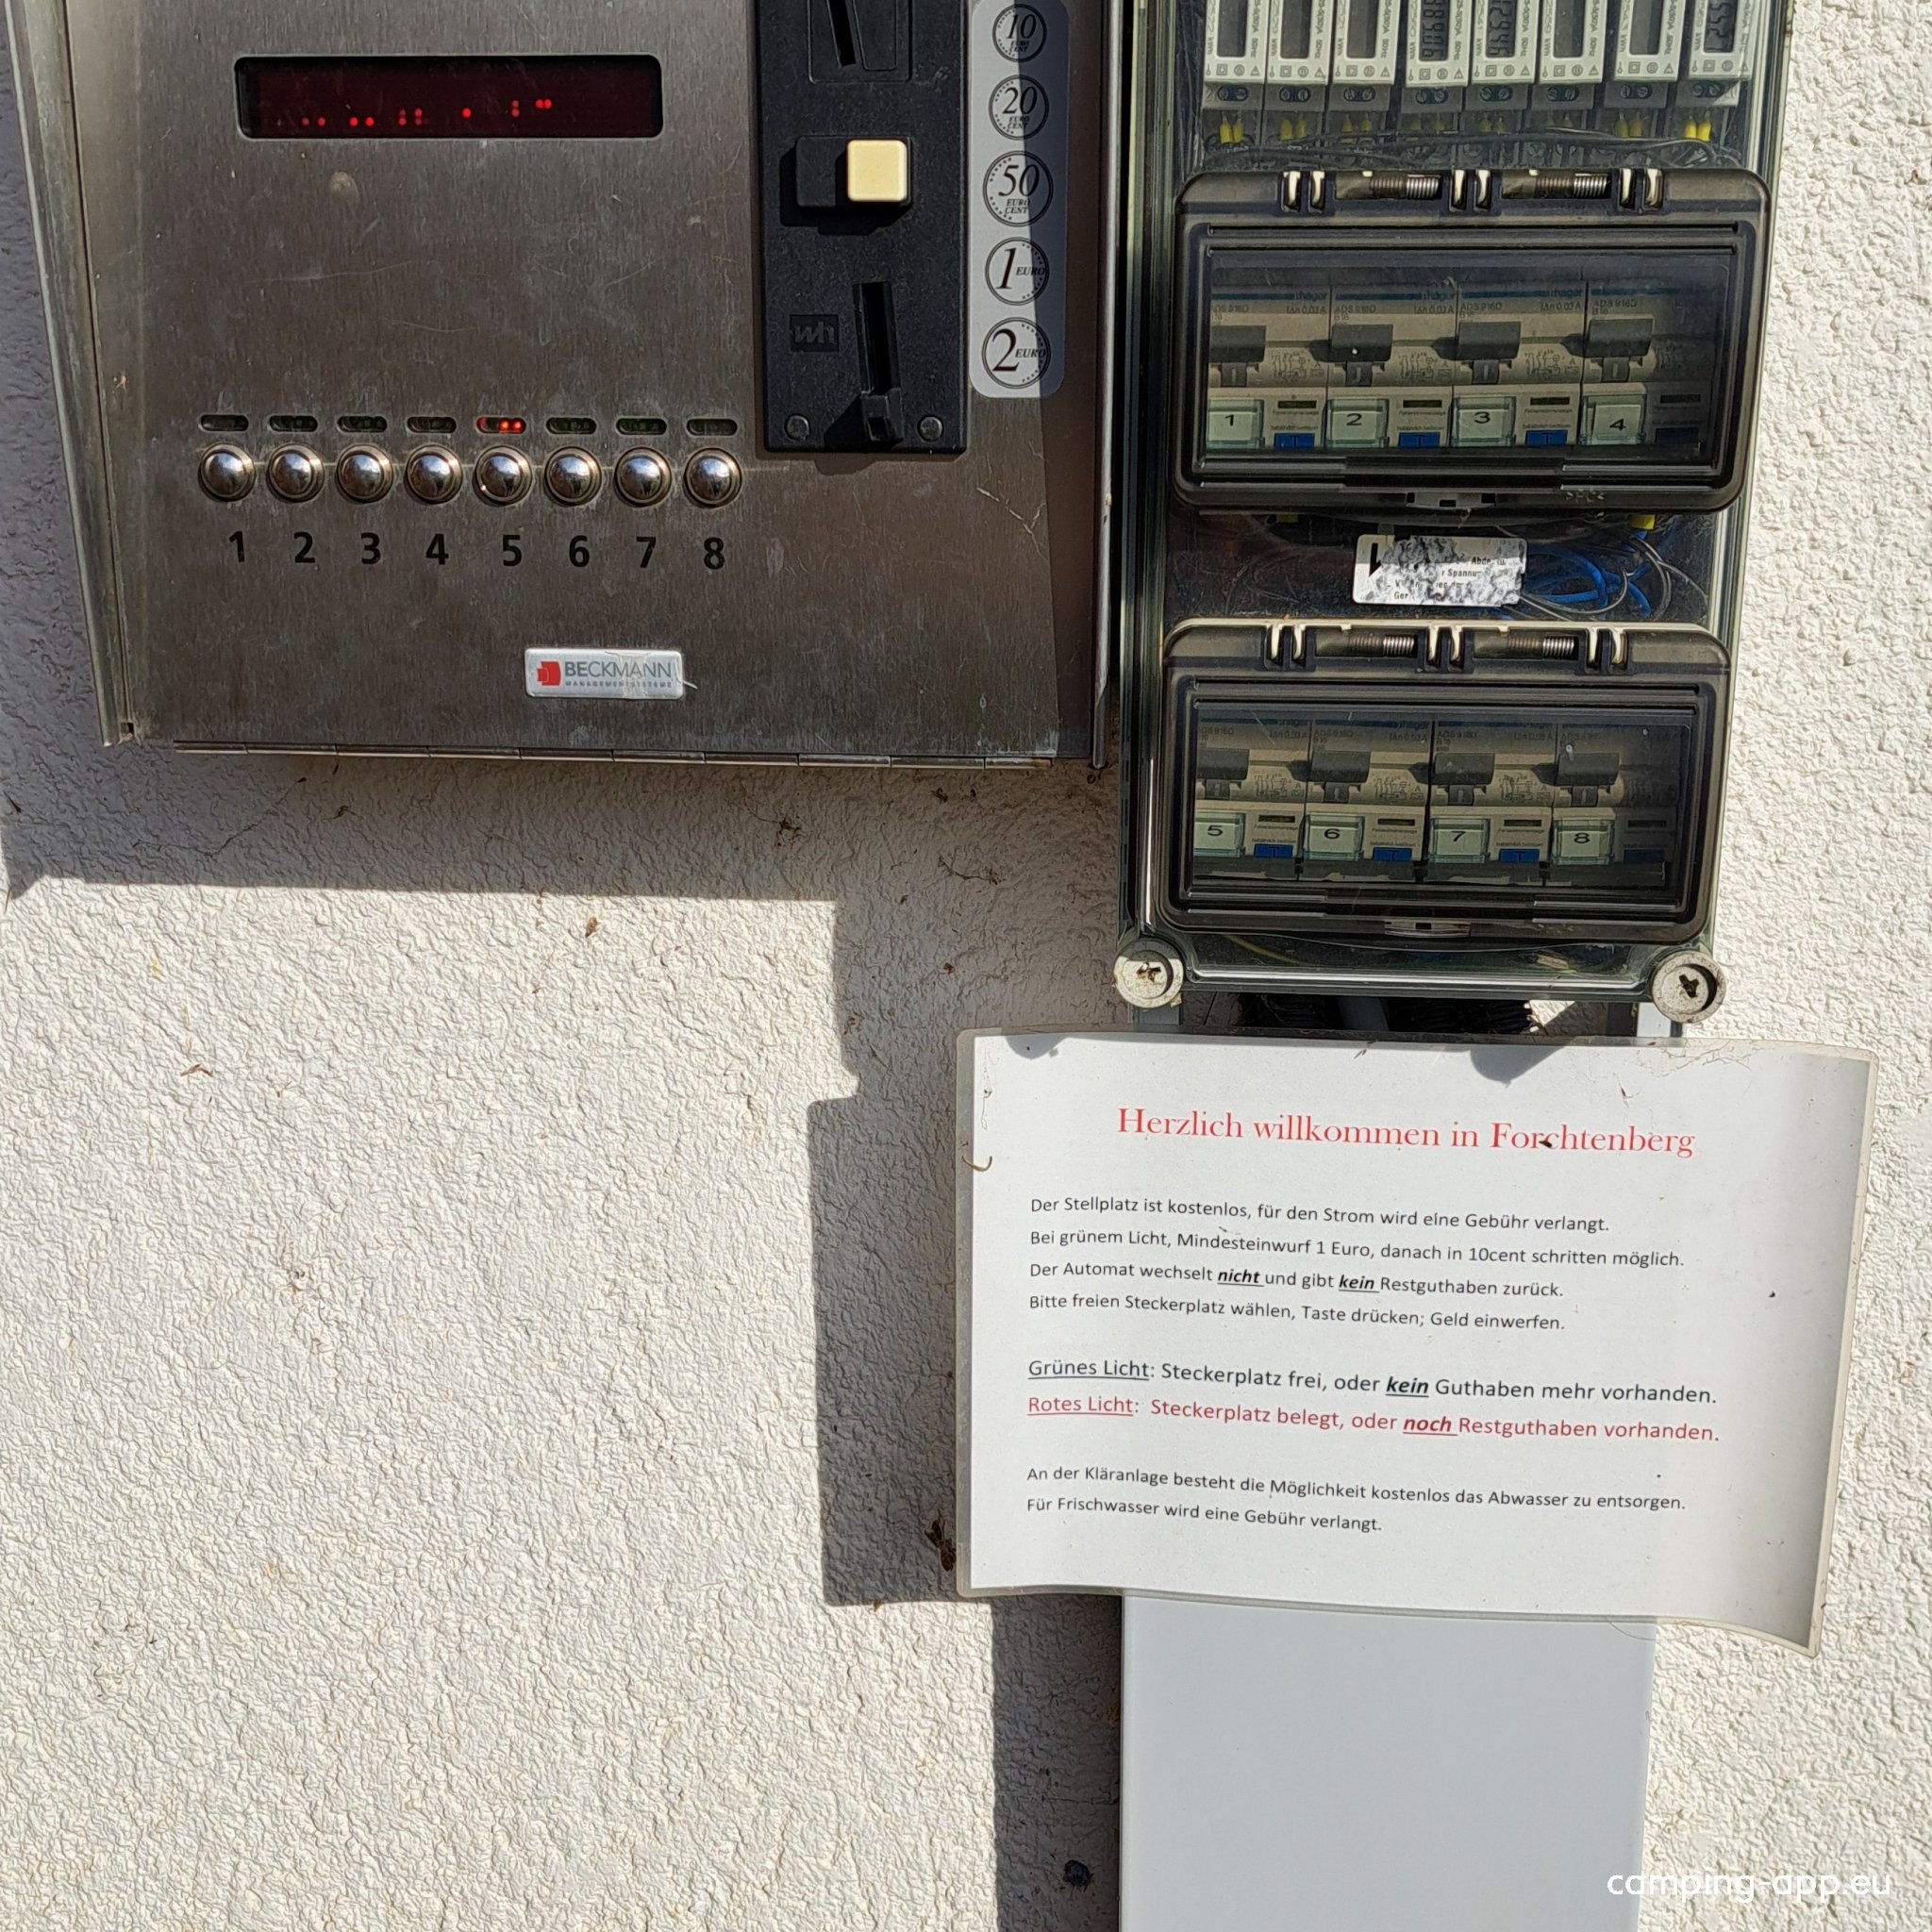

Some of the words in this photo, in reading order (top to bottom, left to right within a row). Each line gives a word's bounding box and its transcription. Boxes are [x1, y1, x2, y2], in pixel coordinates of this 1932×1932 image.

[1006, 13, 1037, 39] 10
[1002, 86, 1038, 114] 20
[998, 164, 1040, 197] 50
[995, 247, 1017, 289] 1
[1015, 267, 1045, 275] EURO
[991, 328, 1020, 372] 2
[1015, 348, 1046, 358] EURO
[1224, 413, 1235, 426] 1
[1346, 412, 1362, 425] 2
[1474, 411, 1491, 424] 3
[1609, 418, 1626, 430] 4
[228, 530, 245, 563] 1
[293, 531, 316, 564] 2
[360, 532, 381, 564] 3
[425, 534, 449, 565] 4
[501, 535, 523, 566] 5
[569, 535, 591, 568] 6
[636, 536, 657, 569] 7
[703, 537, 725, 570] 8
[565, 661, 672, 678] BECKMANN
[1208, 824, 1224, 836] 5
[1324, 828, 1341, 840] 6
[1449, 831, 1466, 842] 7
[1574, 832, 1591, 843] 8
[1118, 1108, 1243, 1138] Herzlich
[1253, 1114, 1440, 1147] willkommen
[1452, 1121, 1479, 1147] in
[1491, 1123, 1695, 1158] Forchtenberg
[1031, 1198, 1059, 1212] Der
[1064, 1196, 1139, 1214] Stellplatz
[1143, 1197, 1163, 1213] ist
[1168, 1198, 1252, 1221] kostenlos,
[1257, 1203, 1282, 1219] für
[1286, 1205, 1318, 1221] den
[1323, 1208, 1374, 1224] Strom
[1380, 1210, 1418, 1225] wird
[1423, 1212, 1460, 1227] eine
[1464, 1213, 1530, 1229] Gebühr
[1534, 1215, 1609, 1235] verlangt.
[1030, 1231, 1055, 1245] Bei
[1059, 1229, 1123, 1247] grünem
[1128, 1230, 1172, 1249] Licht,
[1177, 1233, 1312, 1254] Mindesteinwurf
[1316, 1241, 1325, 1255] 1
[1331, 1241, 1374, 1259] Euro,
[1380, 1242, 1441, 1260] danach
[1447, 1246, 1462, 1260] in
[1469, 1247, 1526, 1263] 10cent
[1531, 1248, 1607, 1265] schritten
[1612, 1251, 1684, 1269] möglich.
[1030, 1263, 1059, 1277] Der
[1062, 1261, 1135, 1277] Automat
[1139, 1264, 1213, 1282] wechselt
[1217, 1268, 1261, 1284] nicht
[1264, 1271, 1297, 1286] und
[1301, 1273, 1335, 1291] gibt
[1338, 1274, 1375, 1291] kein
[1380, 1276, 1498, 1296] Restguthaben
[1503, 1282, 1563, 1297] zurück.
[1029, 1295, 1068, 1309] Bitte
[1072, 1292, 1120, 1308] freien
[1124, 1294, 1225, 1315] Steckerplatz
[1230, 1302, 1296, 1322] wählen,
[1301, 1305, 1346, 1322] Taste
[1351, 1307, 1424, 1327] drücken;
[1430, 1311, 1469, 1327] Geld
[1474, 1313, 1565, 1330] einwerfen.
[1028, 1359, 1097, 1376] Grünes
[1104, 1359, 1155, 1378] Licht:
[1161, 1362, 1282, 1388] Steckerplatz
[1288, 1370, 1327, 1392] frei,
[1334, 1374, 1381, 1392] oder
[1385, 1375, 1429, 1394] kein
[1435, 1378, 1535, 1398] Guthaben
[1541, 1382, 1596, 1400] mehr
[1601, 1383, 1717, 1404] vorhanden.
[1028, 1396, 1082, 1412] Rotes
[1088, 1395, 1140, 1413] Licht:
[1150, 1399, 1271, 1424] Steckerplatz
[1277, 1407, 1344, 1430] belegt,
[1351, 1412, 1398, 1430] oder
[1403, 1415, 1453, 1433] noch
[1458, 1417, 1597, 1439] Restguthaben
[1604, 1421, 1719, 1441] vorhanden.
[1026, 1468, 1048, 1481] An
[1053, 1465, 1080, 1480] der
[1085, 1466, 1169, 1487] Kläranlage
[1174, 1472, 1236, 1491] besteht
[1240, 1476, 1265, 1492] die
[1269, 1479, 1367, 1499] Möglichkeit
[1371, 1484, 1450, 1503] kostenlos
[1455, 1489, 1484, 1504] das
[1488, 1491, 1570, 1507] Abwasser
[1573, 1496, 1591, 1507] zu
[1596, 1495, 1686, 1511] entsorgen.
[1027, 1498, 1053, 1512] Für
[1058, 1497, 1160, 1515] Frischwasser
[1163, 1504, 1200, 1519] wird
[1205, 1507, 1240, 1522] eine
[1244, 1508, 1307, 1526] Gebühr
[1310, 1514, 1382, 1534] verlangt.
